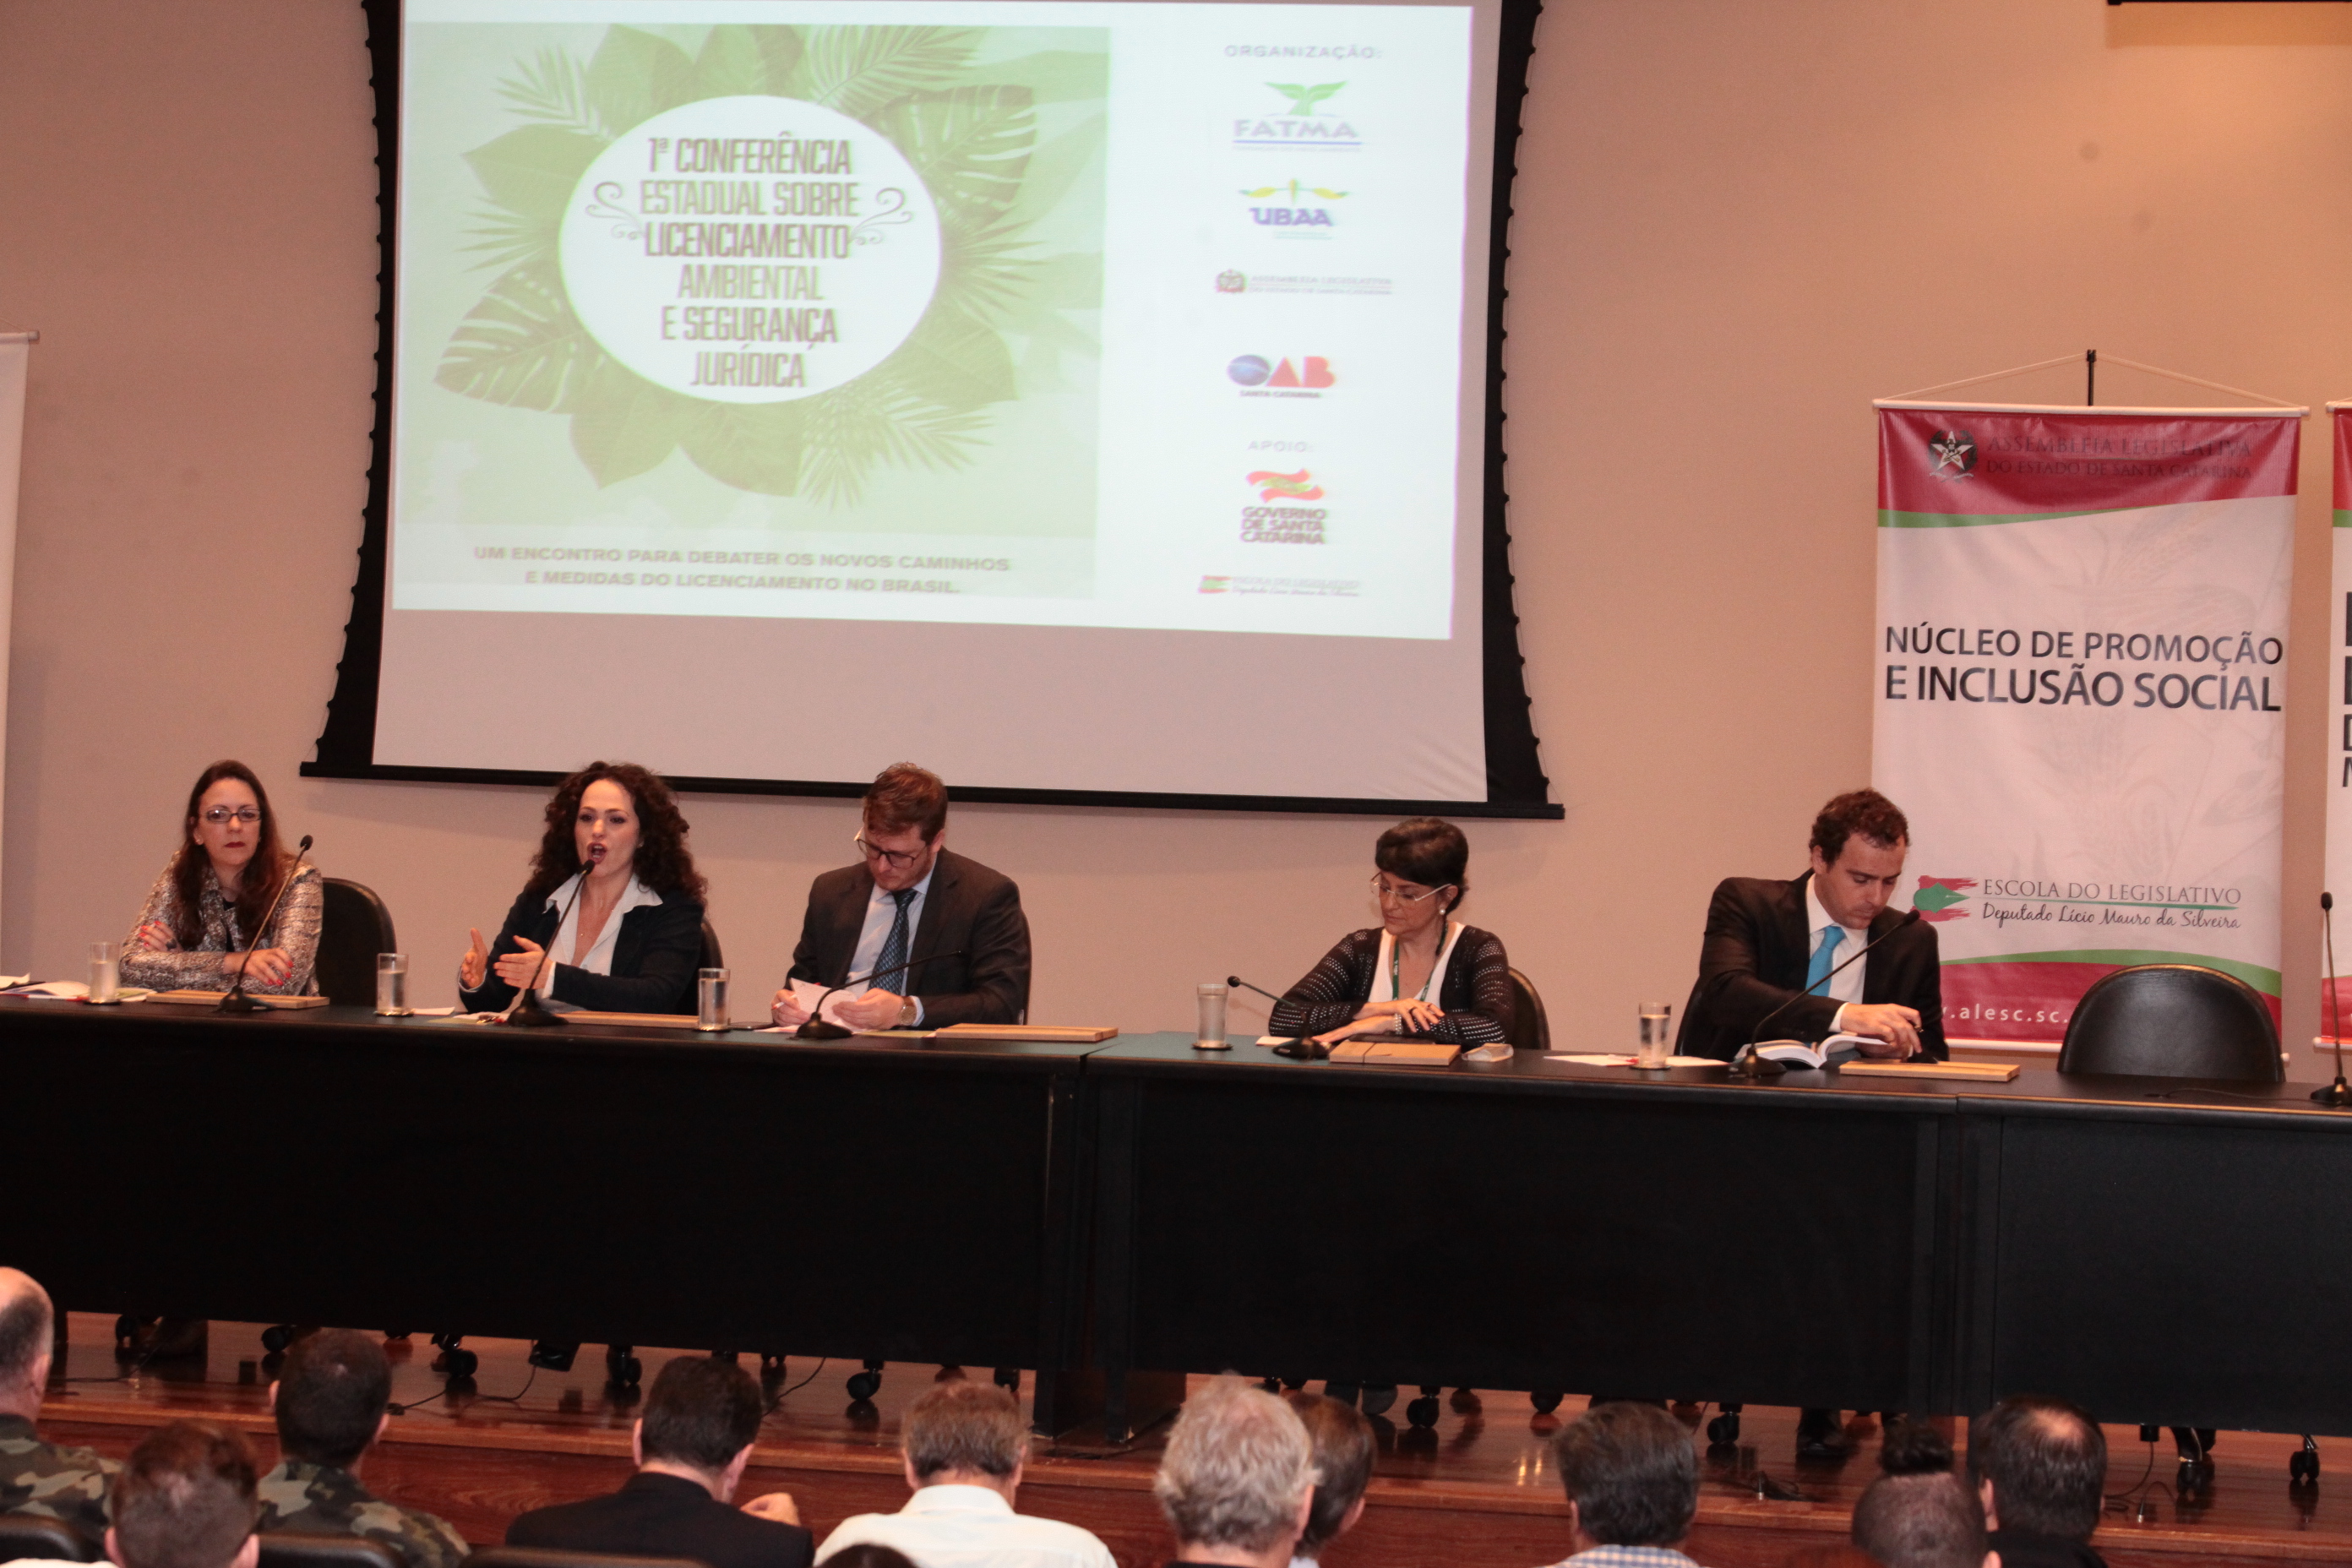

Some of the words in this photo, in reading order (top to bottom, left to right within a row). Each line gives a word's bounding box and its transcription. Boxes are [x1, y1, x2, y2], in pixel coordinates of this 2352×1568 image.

[1224, 44, 1381, 60] ORGANIZAÇÃO:
[1233, 119, 1359, 138] FATMA
[676, 130, 852, 174] CONFERÊNCIA
[640, 180, 766, 216] ESTADUAL
[773, 182, 859, 217] SOBRE
[1249, 208, 1334, 226] UBAA
[645, 222, 851, 259] LICENCIAMENTO
[678, 264, 825, 300] AMBIENTAL
[661, 306, 677, 340] E
[683, 307, 838, 350] SEGURANÇA
[689, 344, 806, 387] JURÍDICA
[1228, 354, 1336, 389] OAB
[1988, 434, 2113, 455] ASSEMBLEIA
[2121, 438, 2251, 458] LEGISLATIVA
[1987, 460, 2014, 475] DO
[2017, 460, 2081, 476] ESTADO
[2086, 462, 2107, 476] DE
[2113, 462, 2165, 478] SANTA
[2169, 465, 2252, 480] CATARINA
[1242, 507, 1327, 520] GOVERNO
[1242, 519, 1264, 531] DE
[1269, 520, 1325, 531] SANTA
[1240, 531, 1326, 544] CATARINA
[473, 547, 506, 559] UM
[511, 547, 622, 562] ENCONTRO
[628, 549, 682, 563] PARA
[688, 550, 780, 564] DEBATER
[785, 553, 814, 566] OS
[819, 553, 894, 568] NOVOS
[898, 556, 1011, 571] CAMINHOS
[525, 570, 540, 584] E
[542, 571, 635, 585] MEDIDAS
[640, 573, 671, 586] DO
[676, 574, 840, 591] LICENCIAMENTO
[845, 578, 876, 591] NO
[1886, 621, 2021, 656] NÚCLEO
[2031, 630, 2074, 659] DE
[2084, 631, 2284, 671] PROMOÇÃO
[1886, 664, 1907, 700] E
[1917, 663, 2125, 708] INCLUSÃO
[2133, 672, 2282, 712] SOCIAL
[1984, 879, 2061, 898] ESCOLA
[2067, 882, 2101, 899] DO
[2109, 884, 2242, 905] LEGISLATIVO
[1983, 901, 2053, 928] Deputado
[2058, 905, 2095, 923] Lício
[2099, 906, 2151, 926] Mauro
[2156, 907, 2176, 927] da
[2180, 908, 2242, 928] Silveira
